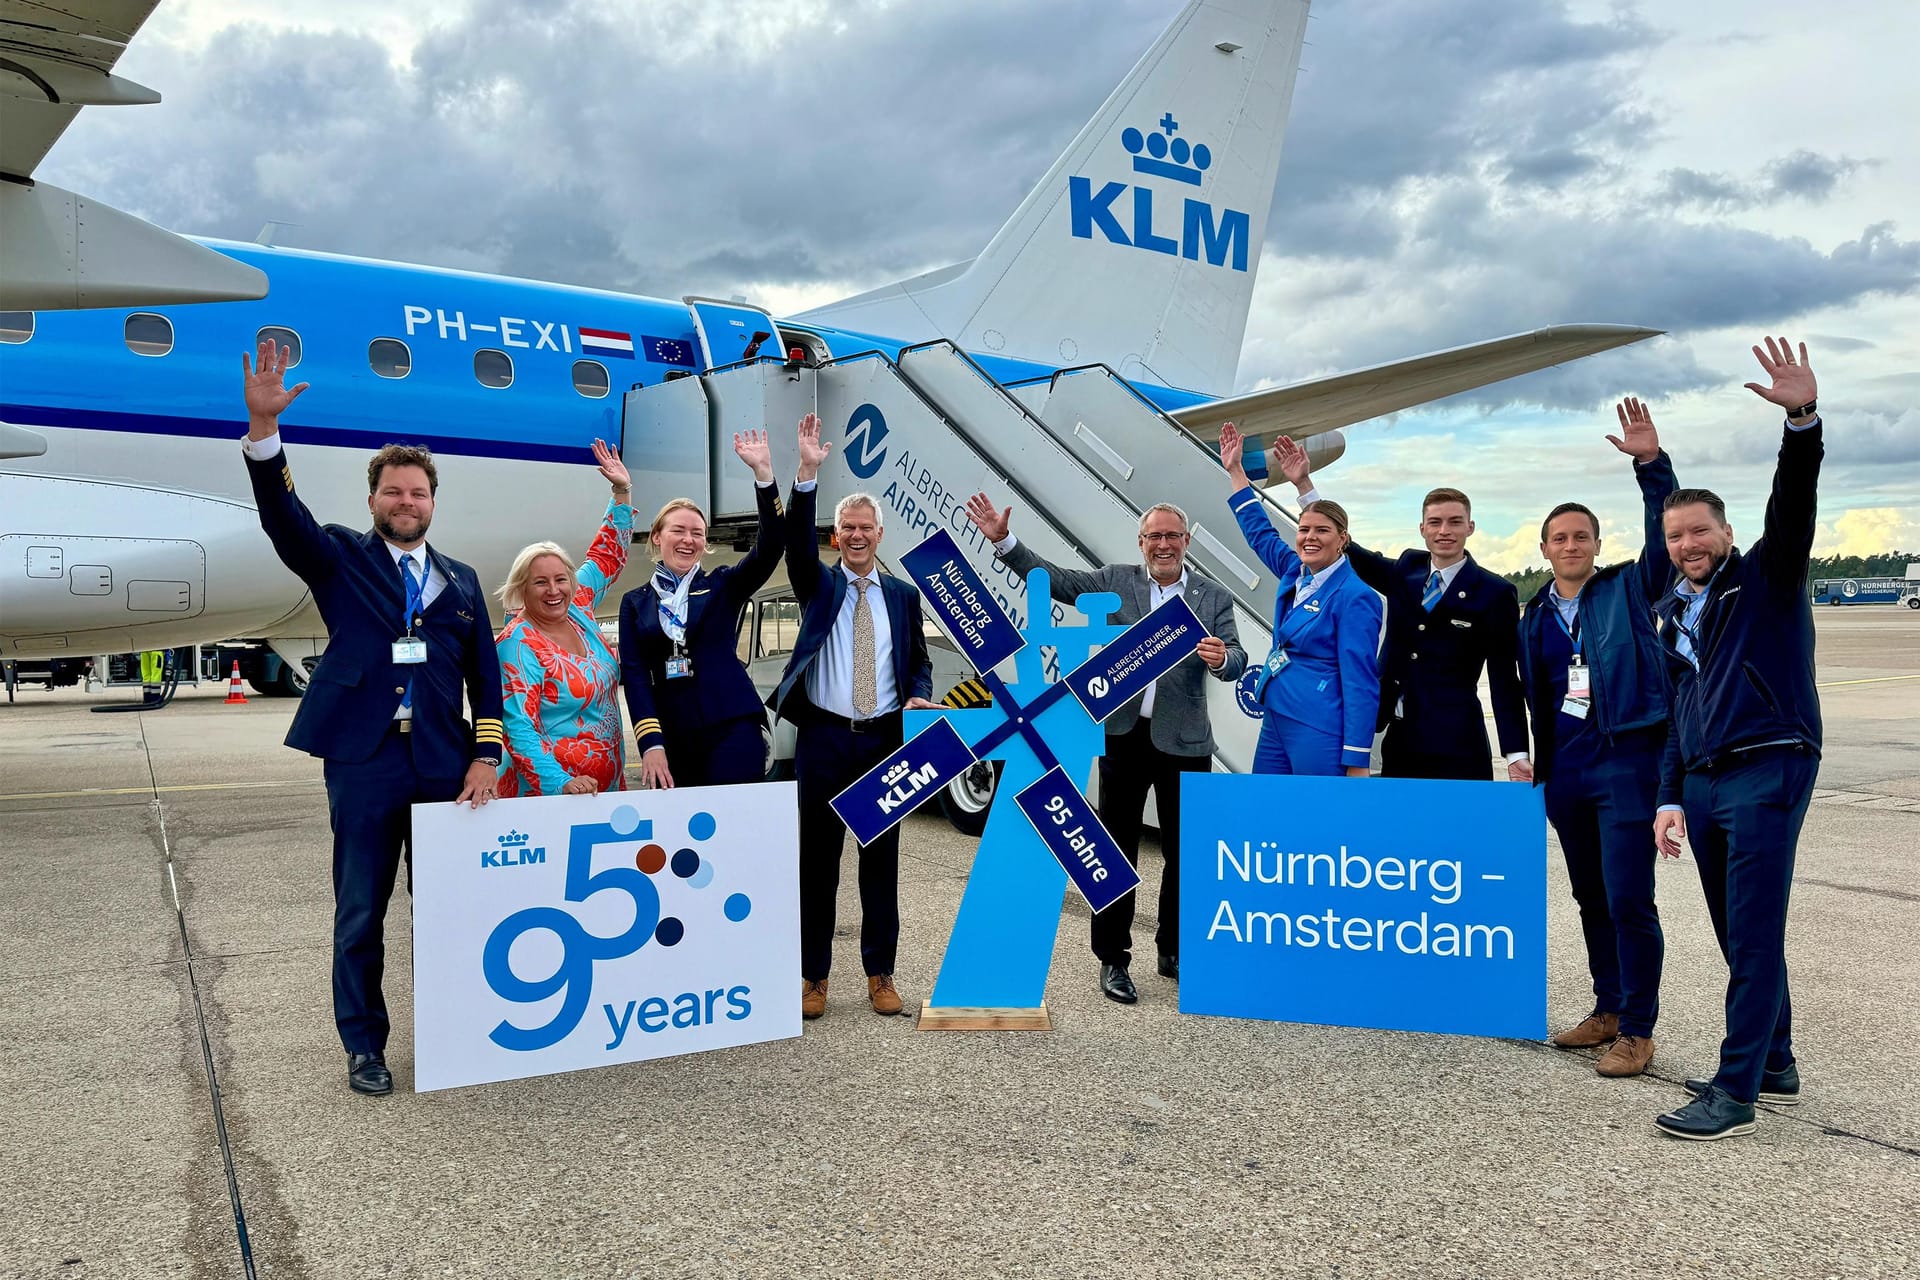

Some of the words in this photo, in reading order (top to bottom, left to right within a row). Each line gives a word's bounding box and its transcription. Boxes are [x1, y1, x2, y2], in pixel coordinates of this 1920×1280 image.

[1069, 176, 1249, 272] KLM
[404, 305, 572, 353] PH-EXI
[925, 573, 985, 649] Amsterdam
[941, 559, 993, 629] Nürnberg
[1107, 644, 1145, 677] ALBRECHT
[1112, 656, 1145, 685] AIRPORT
[876, 762, 939, 815] KLM
[481, 847, 546, 868] KLM
[1044, 795, 1073, 826] 95
[1062, 826, 1109, 883] Jahre
[1217, 840, 1463, 904] Nürnberg
[482, 819, 661, 1051] 95
[1207, 900, 1514, 959] Amsterdam
[603, 985, 752, 1051] years
